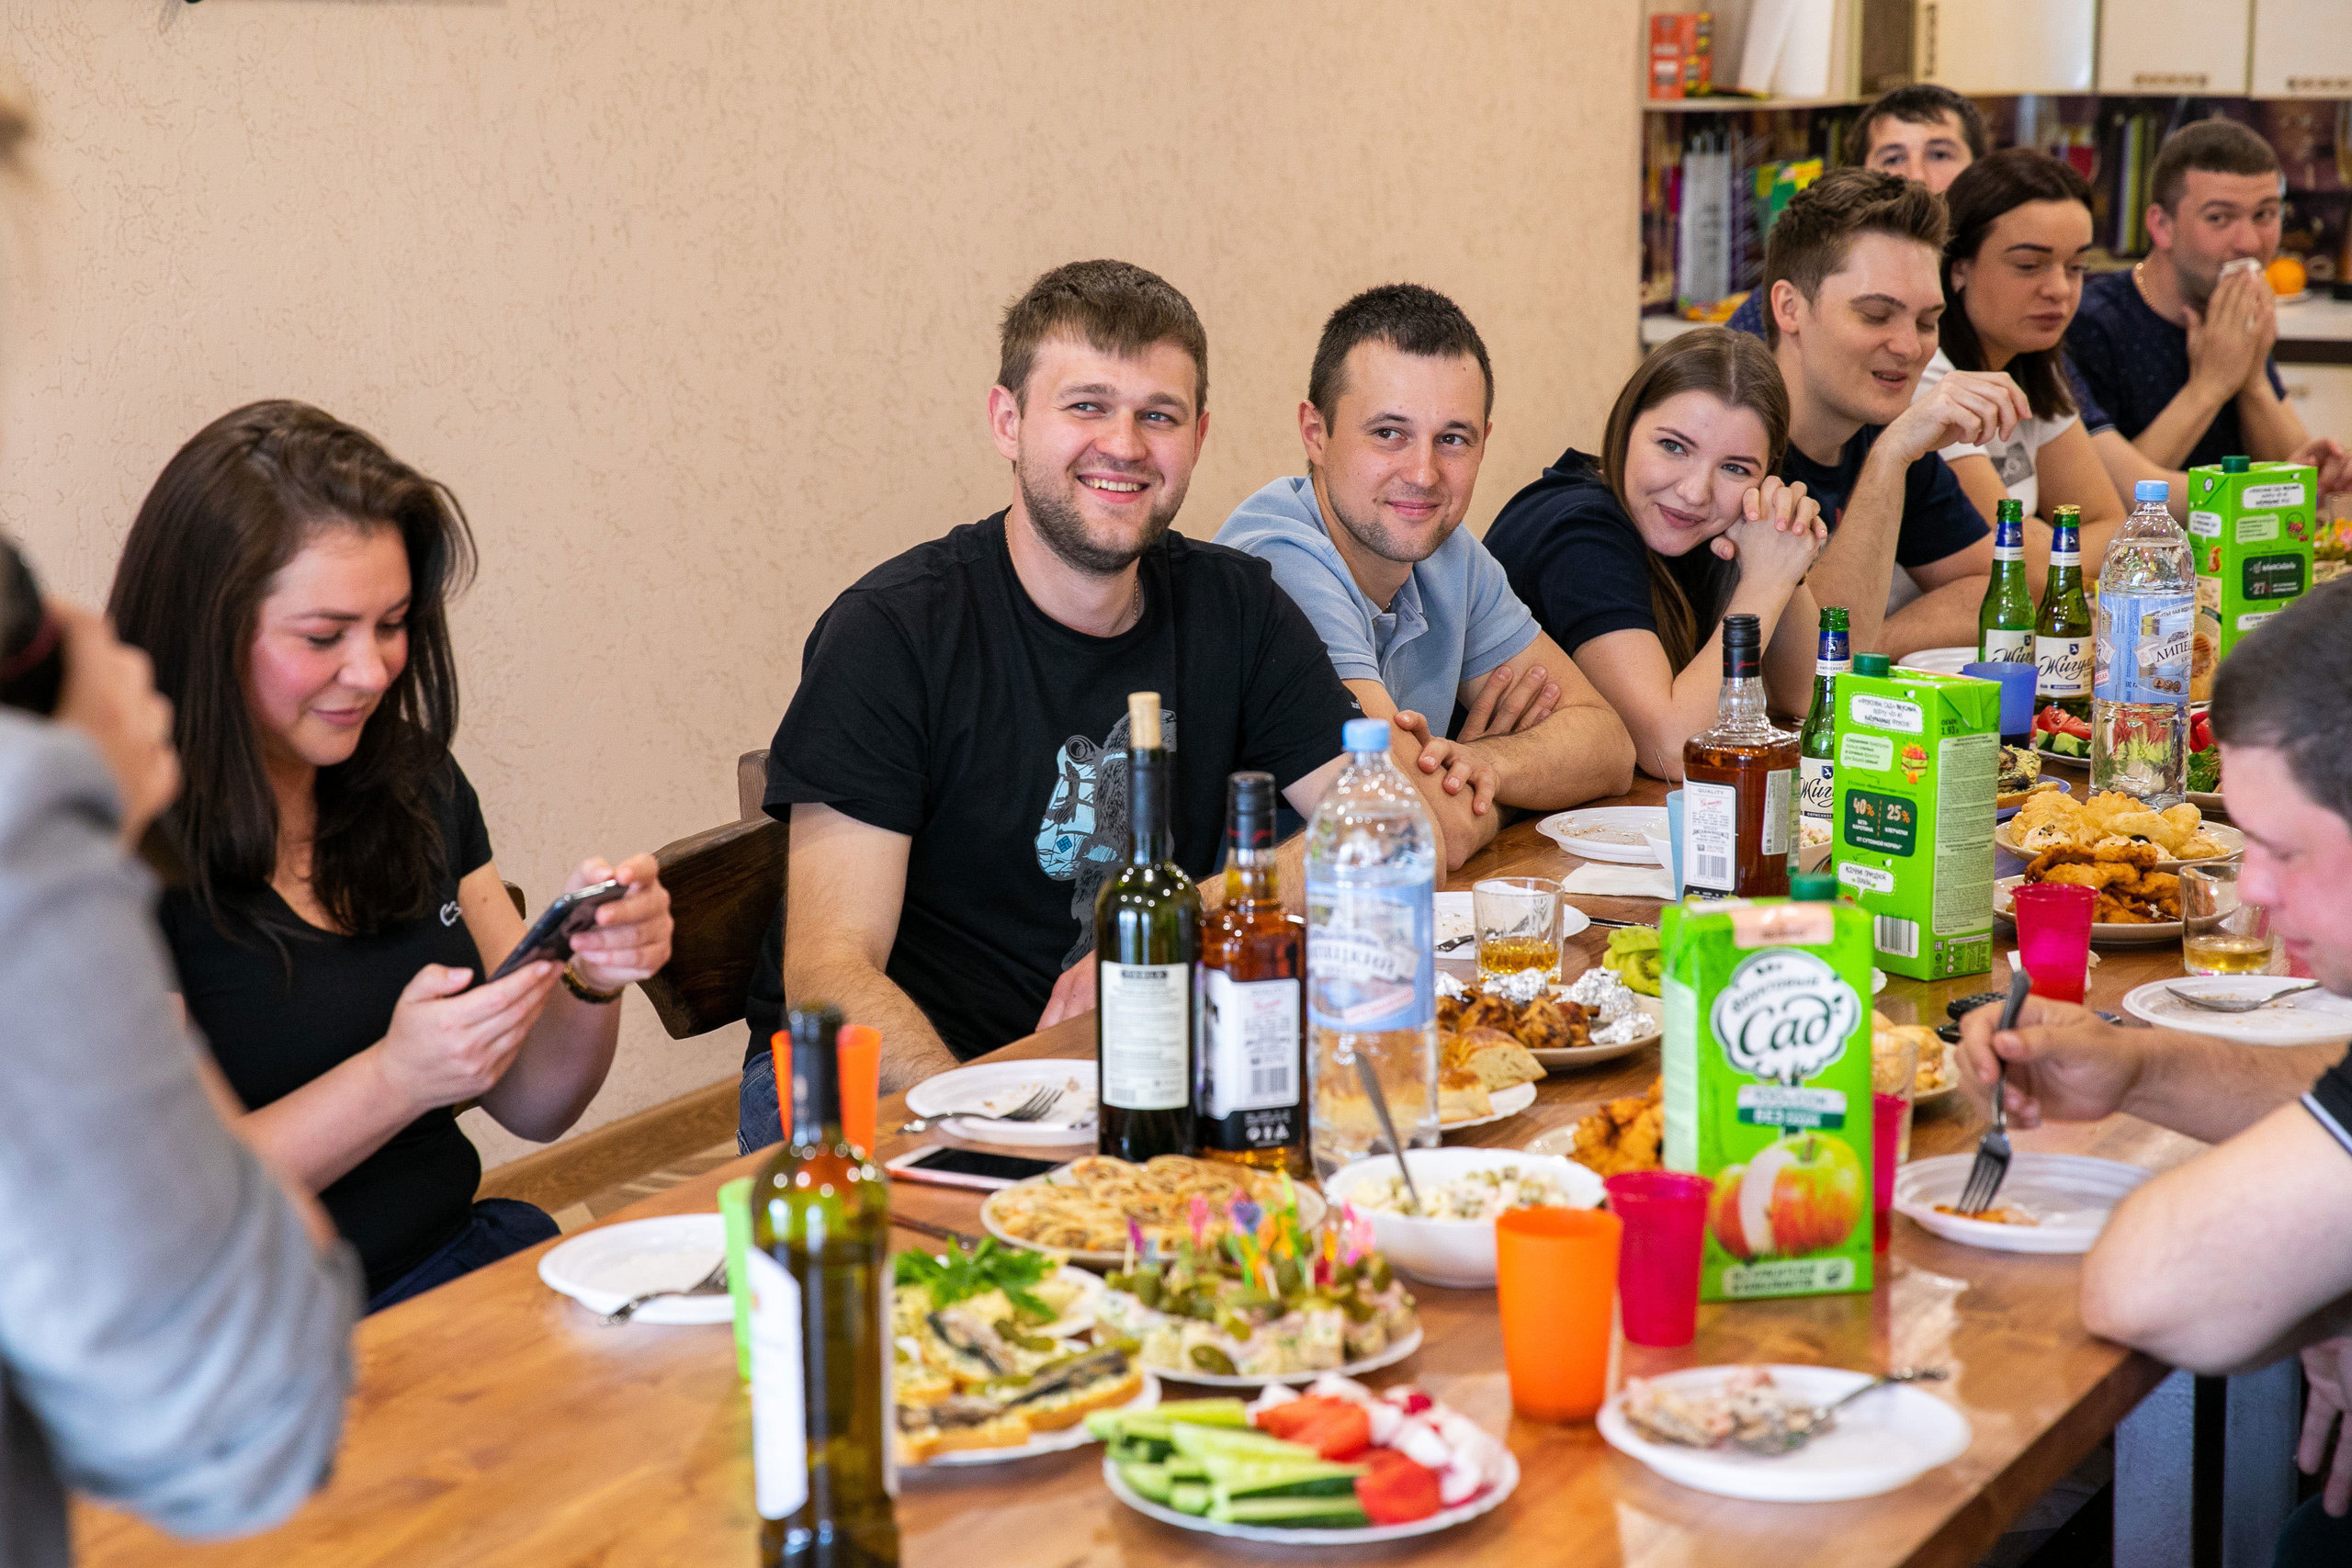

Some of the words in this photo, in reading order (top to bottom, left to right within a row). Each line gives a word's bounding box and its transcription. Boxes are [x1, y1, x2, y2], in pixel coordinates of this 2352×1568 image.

[1853, 797, 1874, 817] 40%
[1886, 804, 1910, 823] 25%
[1739, 993, 1831, 1056] Сад
